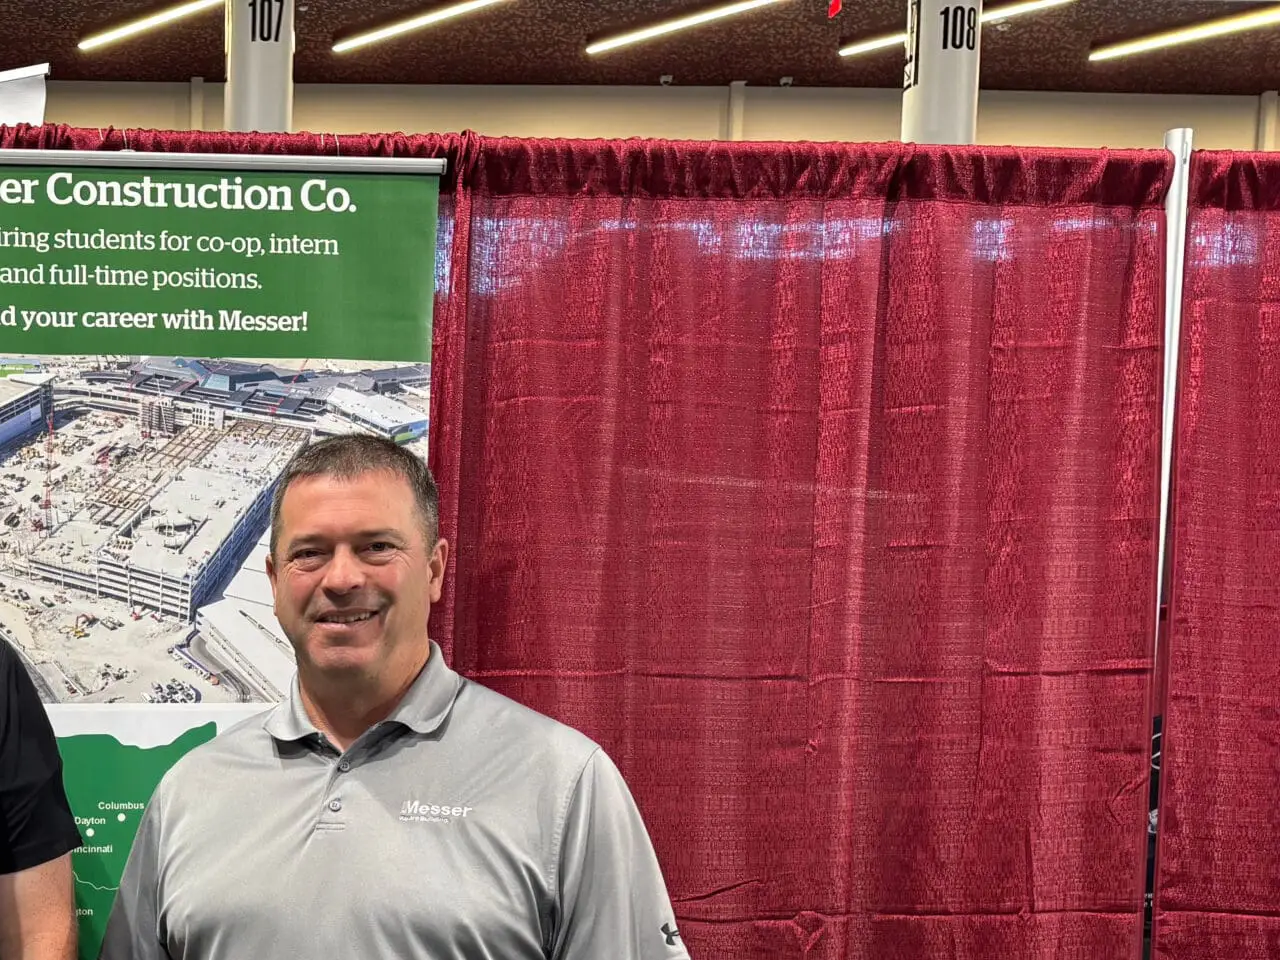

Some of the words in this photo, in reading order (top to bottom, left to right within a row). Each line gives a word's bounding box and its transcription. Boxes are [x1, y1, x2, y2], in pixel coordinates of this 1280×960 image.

[248, 0, 284, 42] 107
[939, 6, 976, 50] 108
[46, 172, 294, 211] Construction
[300, 178, 357, 213] Co.
[53, 228, 155, 250] students
[159, 229, 192, 251] for
[196, 235, 265, 257] co-op,
[269, 232, 339, 255] intern
[0, 263, 45, 284] and
[48, 263, 148, 286] full-time
[152, 267, 262, 291] positions.
[20, 310, 78, 331] your
[82, 311, 158, 328] career
[161, 308, 214, 330] with
[218, 309, 308, 331] Messer!
[98, 801, 145, 811] Columbus
[400, 800, 473, 818] Messer
[74, 816, 106, 827] Dayton
[72, 844, 113, 854] incinnati
